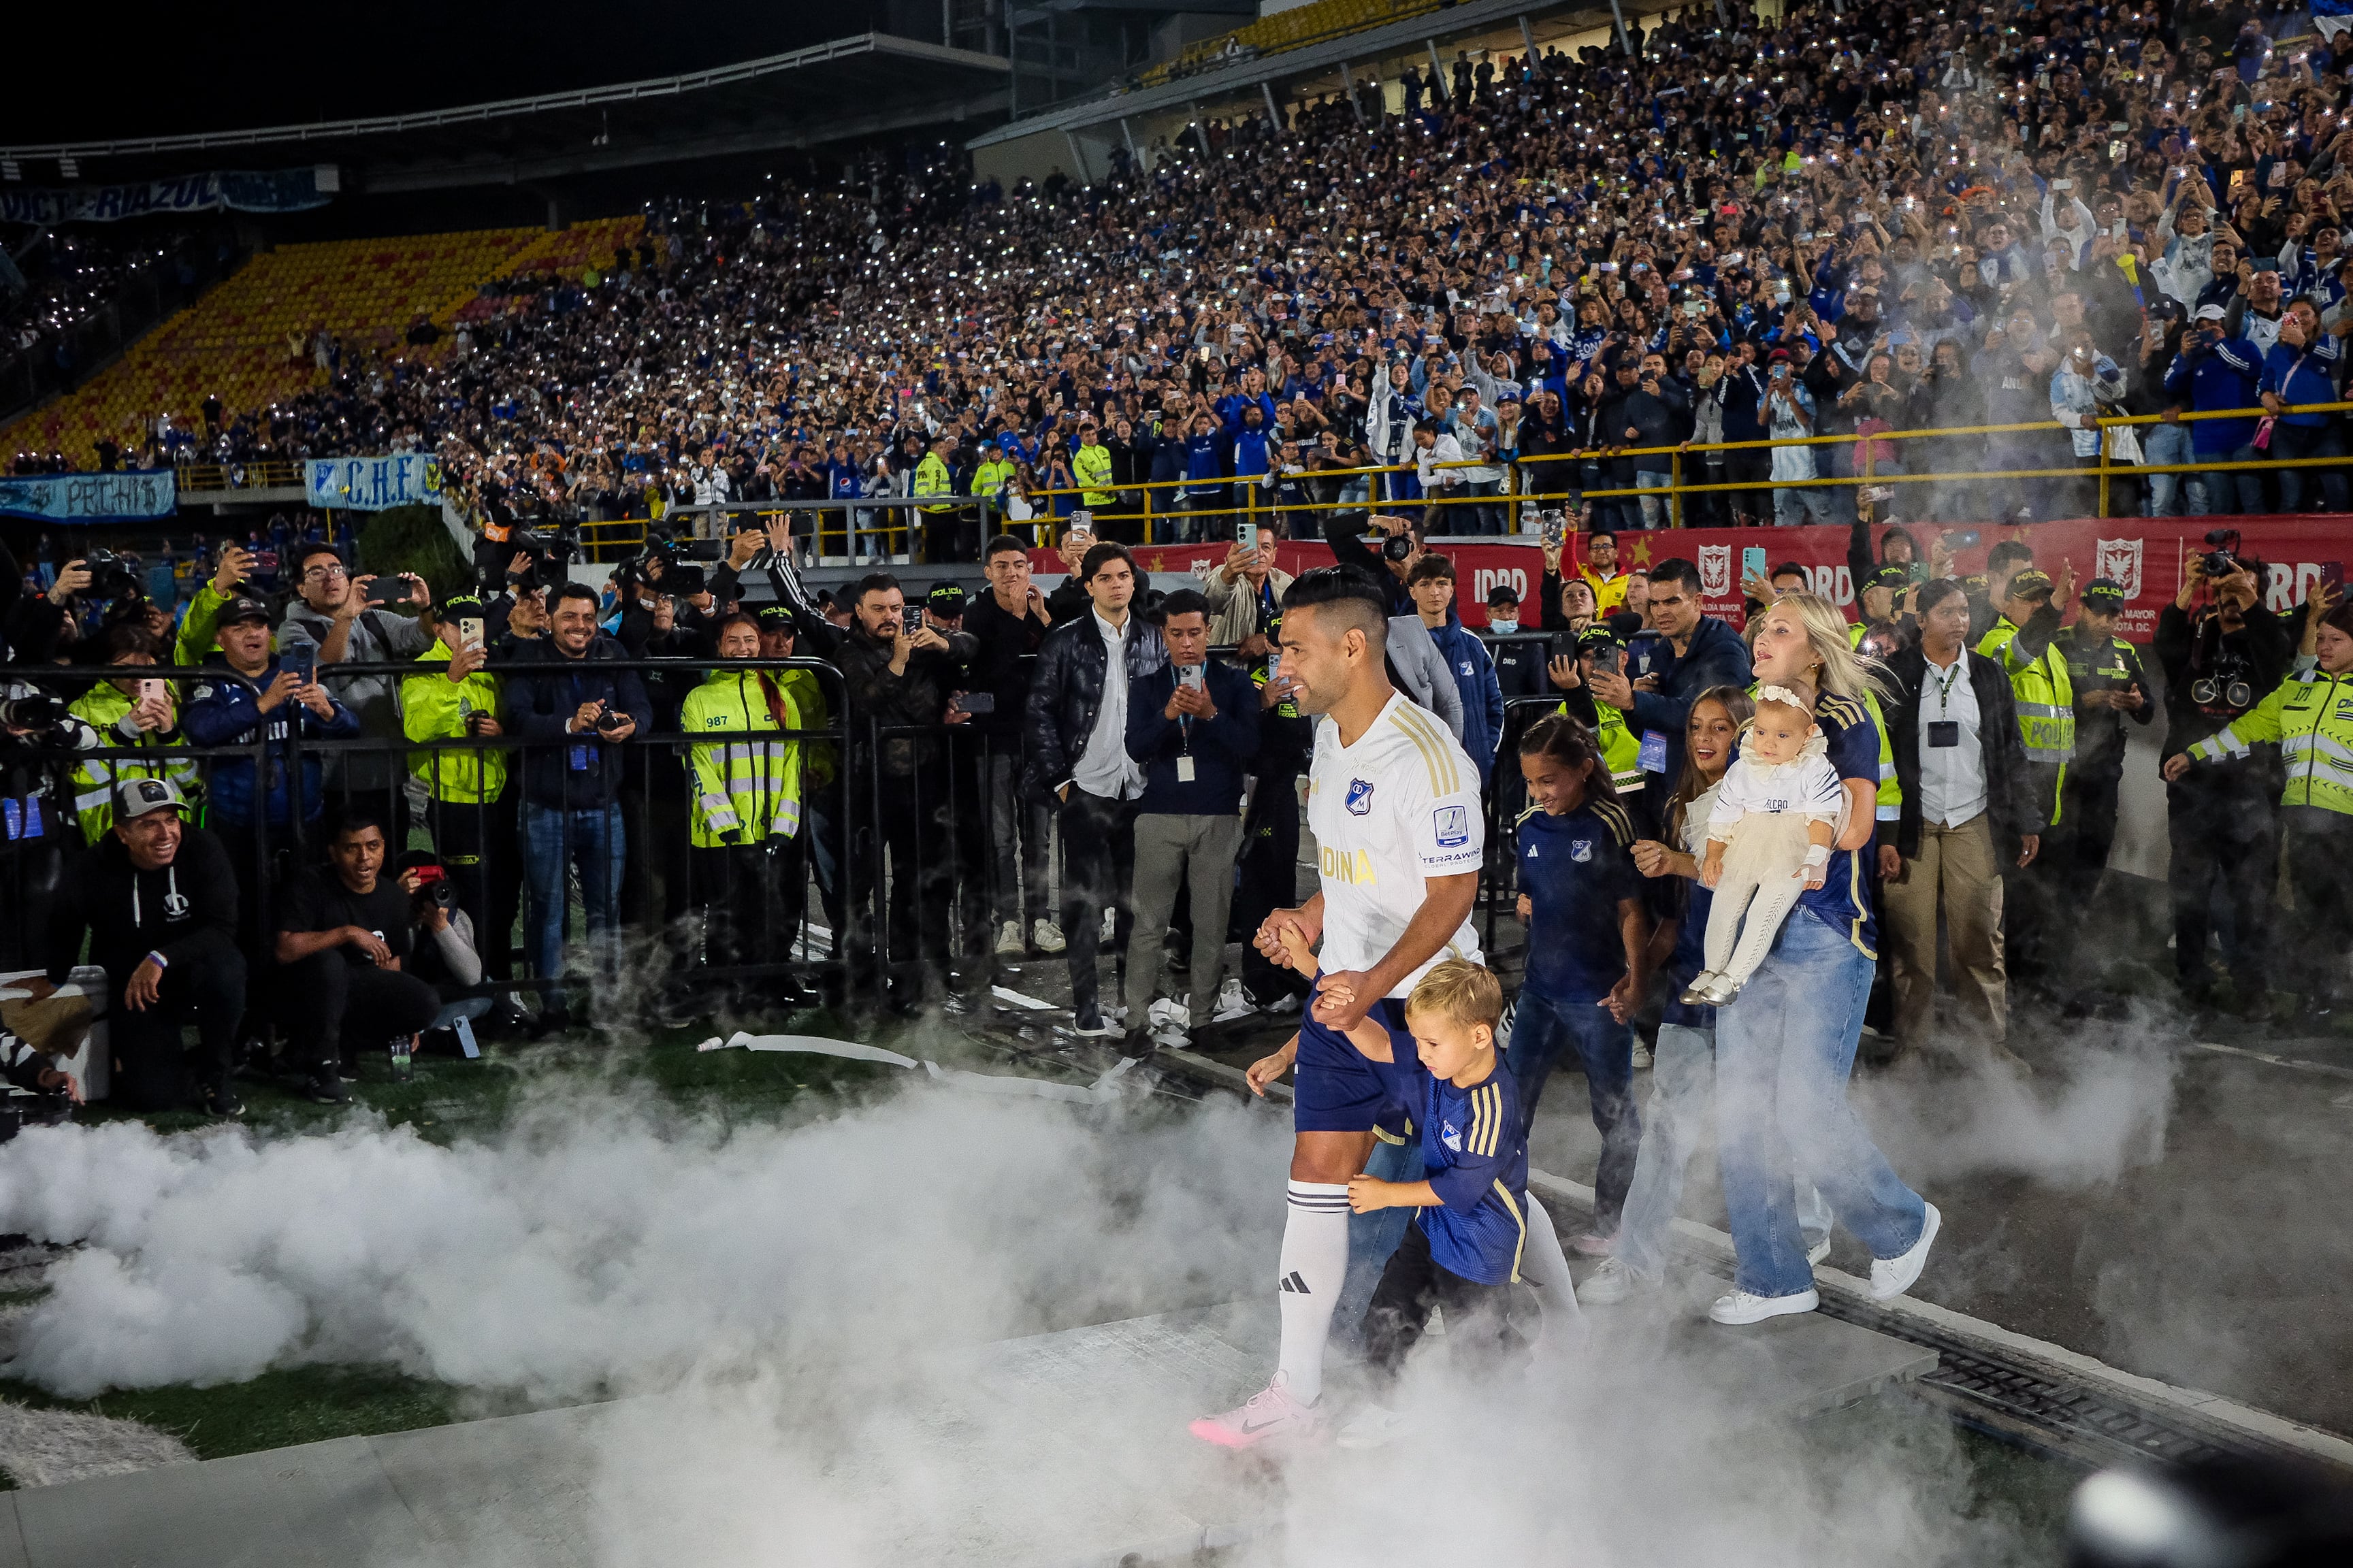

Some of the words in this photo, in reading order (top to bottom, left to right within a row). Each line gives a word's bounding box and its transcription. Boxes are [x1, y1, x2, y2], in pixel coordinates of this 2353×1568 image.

[2125, 610, 2156, 619] MAYOR
[707, 715, 728, 728] 987
[1422, 847, 1480, 864] TERRAWIND
